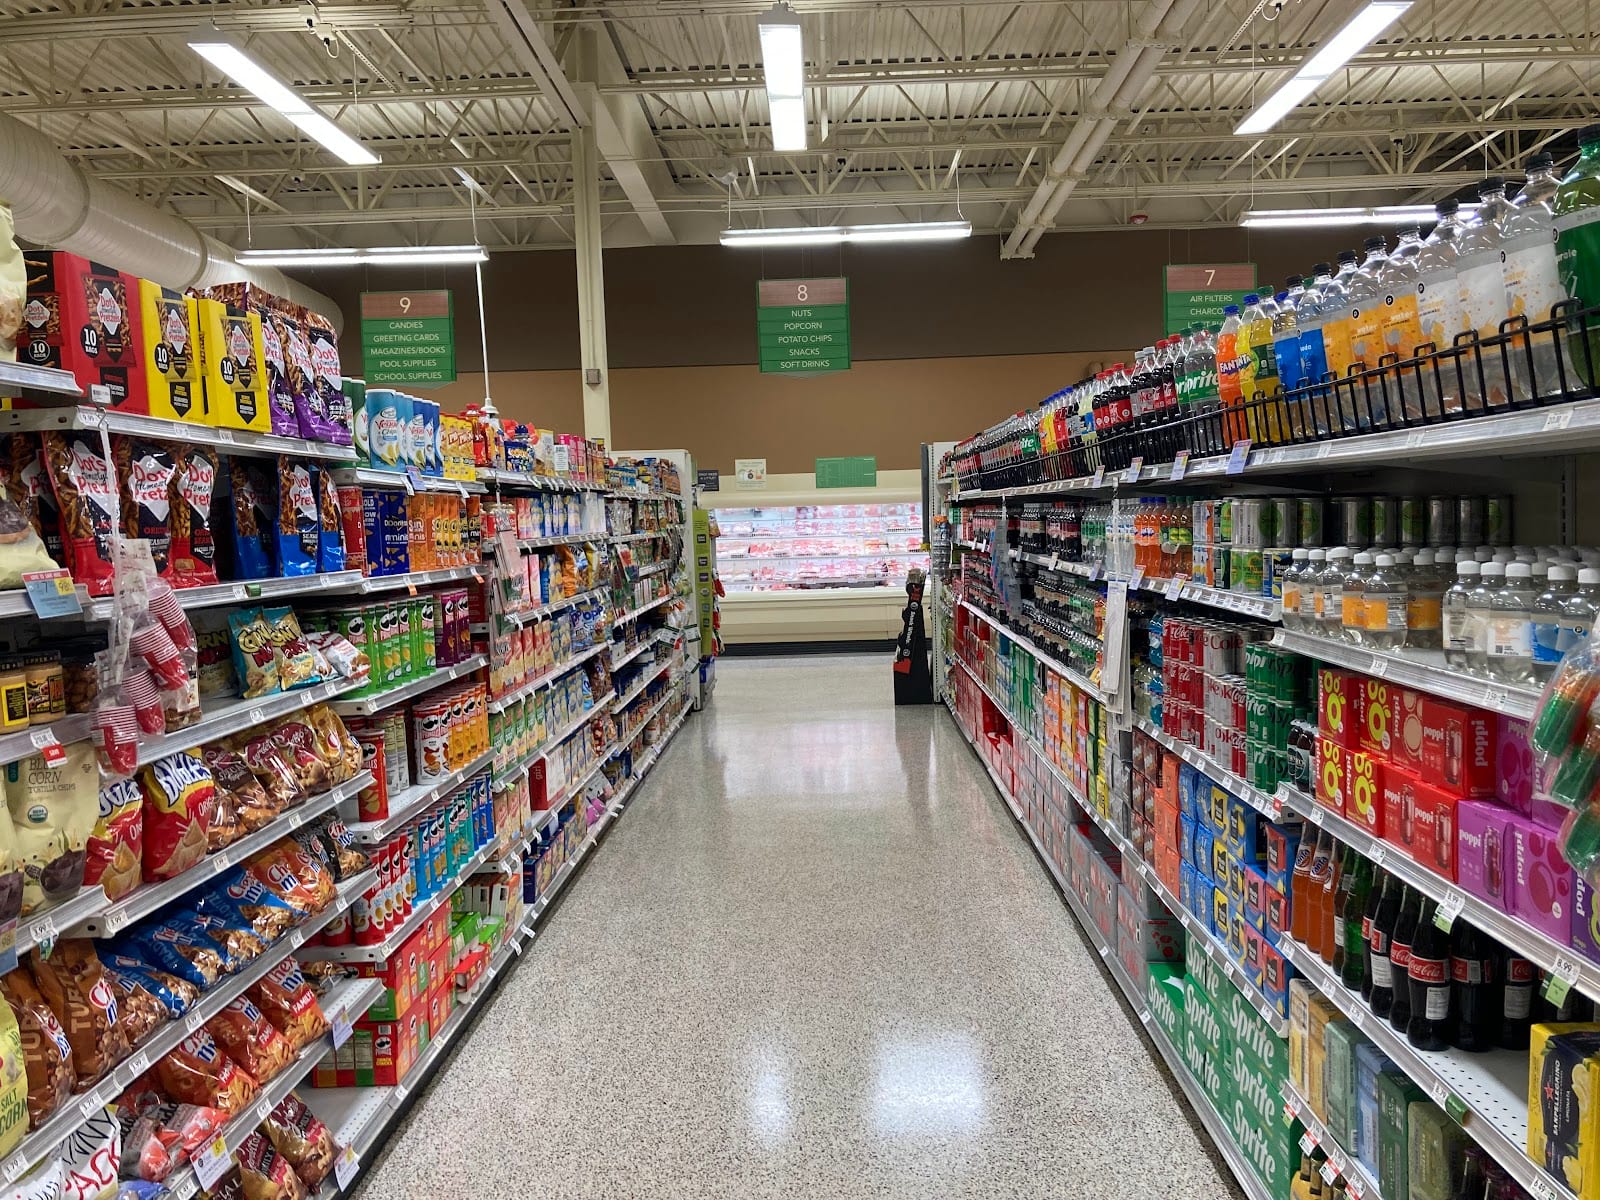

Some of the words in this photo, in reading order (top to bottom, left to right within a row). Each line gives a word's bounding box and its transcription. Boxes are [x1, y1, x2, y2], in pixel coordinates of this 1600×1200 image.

[1204, 269, 1216, 286] 7
[797, 284, 808, 301] 8
[1205, 294, 1233, 302] FILTERS
[399, 297, 411, 314] 9
[791, 309, 812, 317] NUTS
[1190, 308, 1224, 316] CHARCO
[389, 321, 424, 329] CANDIES
[784, 322, 823, 330] POPCORN
[83, 328, 97, 346] 10
[373, 334, 412, 343] GREETING
[413, 333, 440, 341] CARDS
[778, 335, 808, 343] POTATO
[809, 334, 833, 342] CHIPS
[32, 342, 46, 354] 10
[156, 346, 168, 362] 10
[370, 346, 446, 355] MAGAZINES/BOOKS
[789, 347, 820, 356] SNACKS
[222, 360, 233, 375] 10
[380, 360, 401, 368] POOL
[403, 359, 437, 367] SUPPLIES
[780, 361, 800, 369] SOFT
[801, 359, 830, 368] DRINKS
[408, 371, 442, 380] SUPPLIES
[1423, 725, 1444, 741] poppi
[28, 770, 62, 785] CORN
[1414, 807, 1434, 824] poppi
[1459, 829, 1481, 848] poppi
[1186, 935, 1220, 998] Sprite
[1150, 975, 1176, 1033] Sprite
[1184, 983, 1221, 1049] Sprite
[1229, 992, 1275, 1069] Sprite
[1186, 1030, 1221, 1099] Sprite
[1233, 1046, 1276, 1127] Sprite
[1233, 1099, 1277, 1184] Sprite
